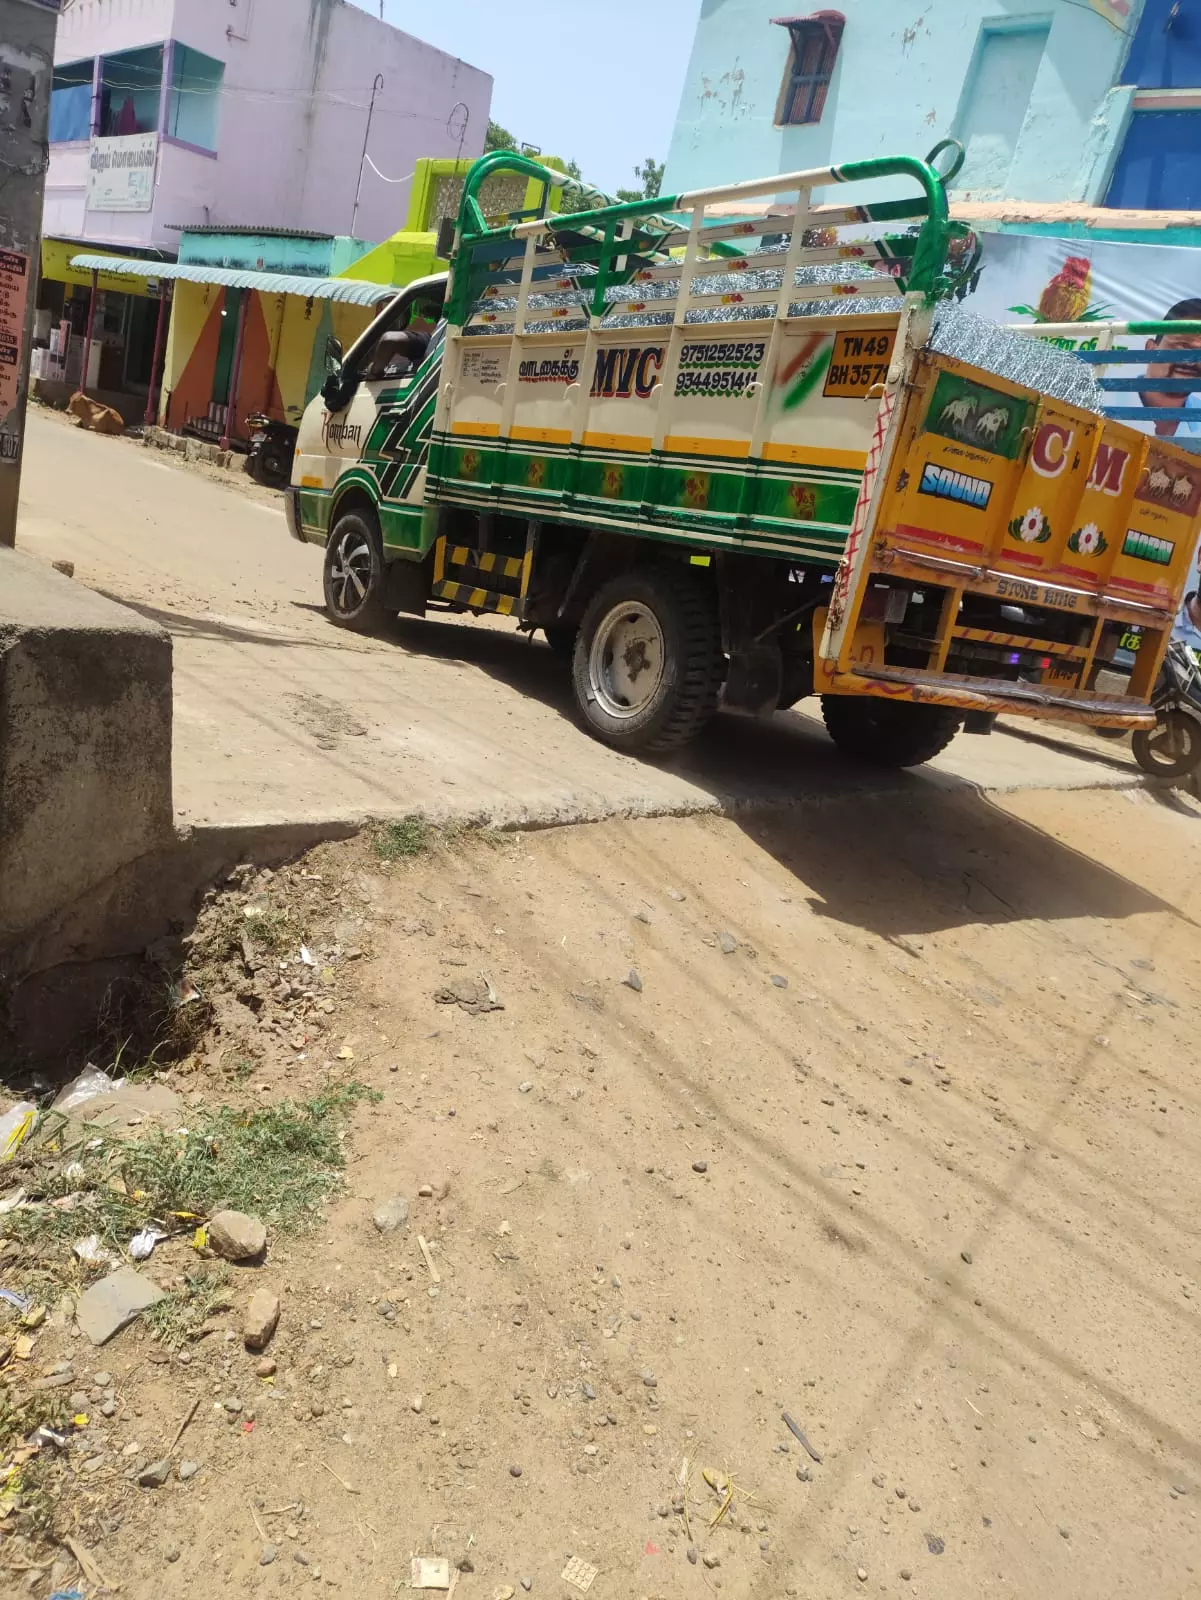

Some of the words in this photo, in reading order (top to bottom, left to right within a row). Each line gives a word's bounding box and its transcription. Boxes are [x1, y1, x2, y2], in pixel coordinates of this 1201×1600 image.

[519, 348, 579, 380] வாடகைக்கு
[680, 343, 766, 363] 9751252523
[588, 346, 666, 399] MVC
[921, 464, 992, 509] SOUND
